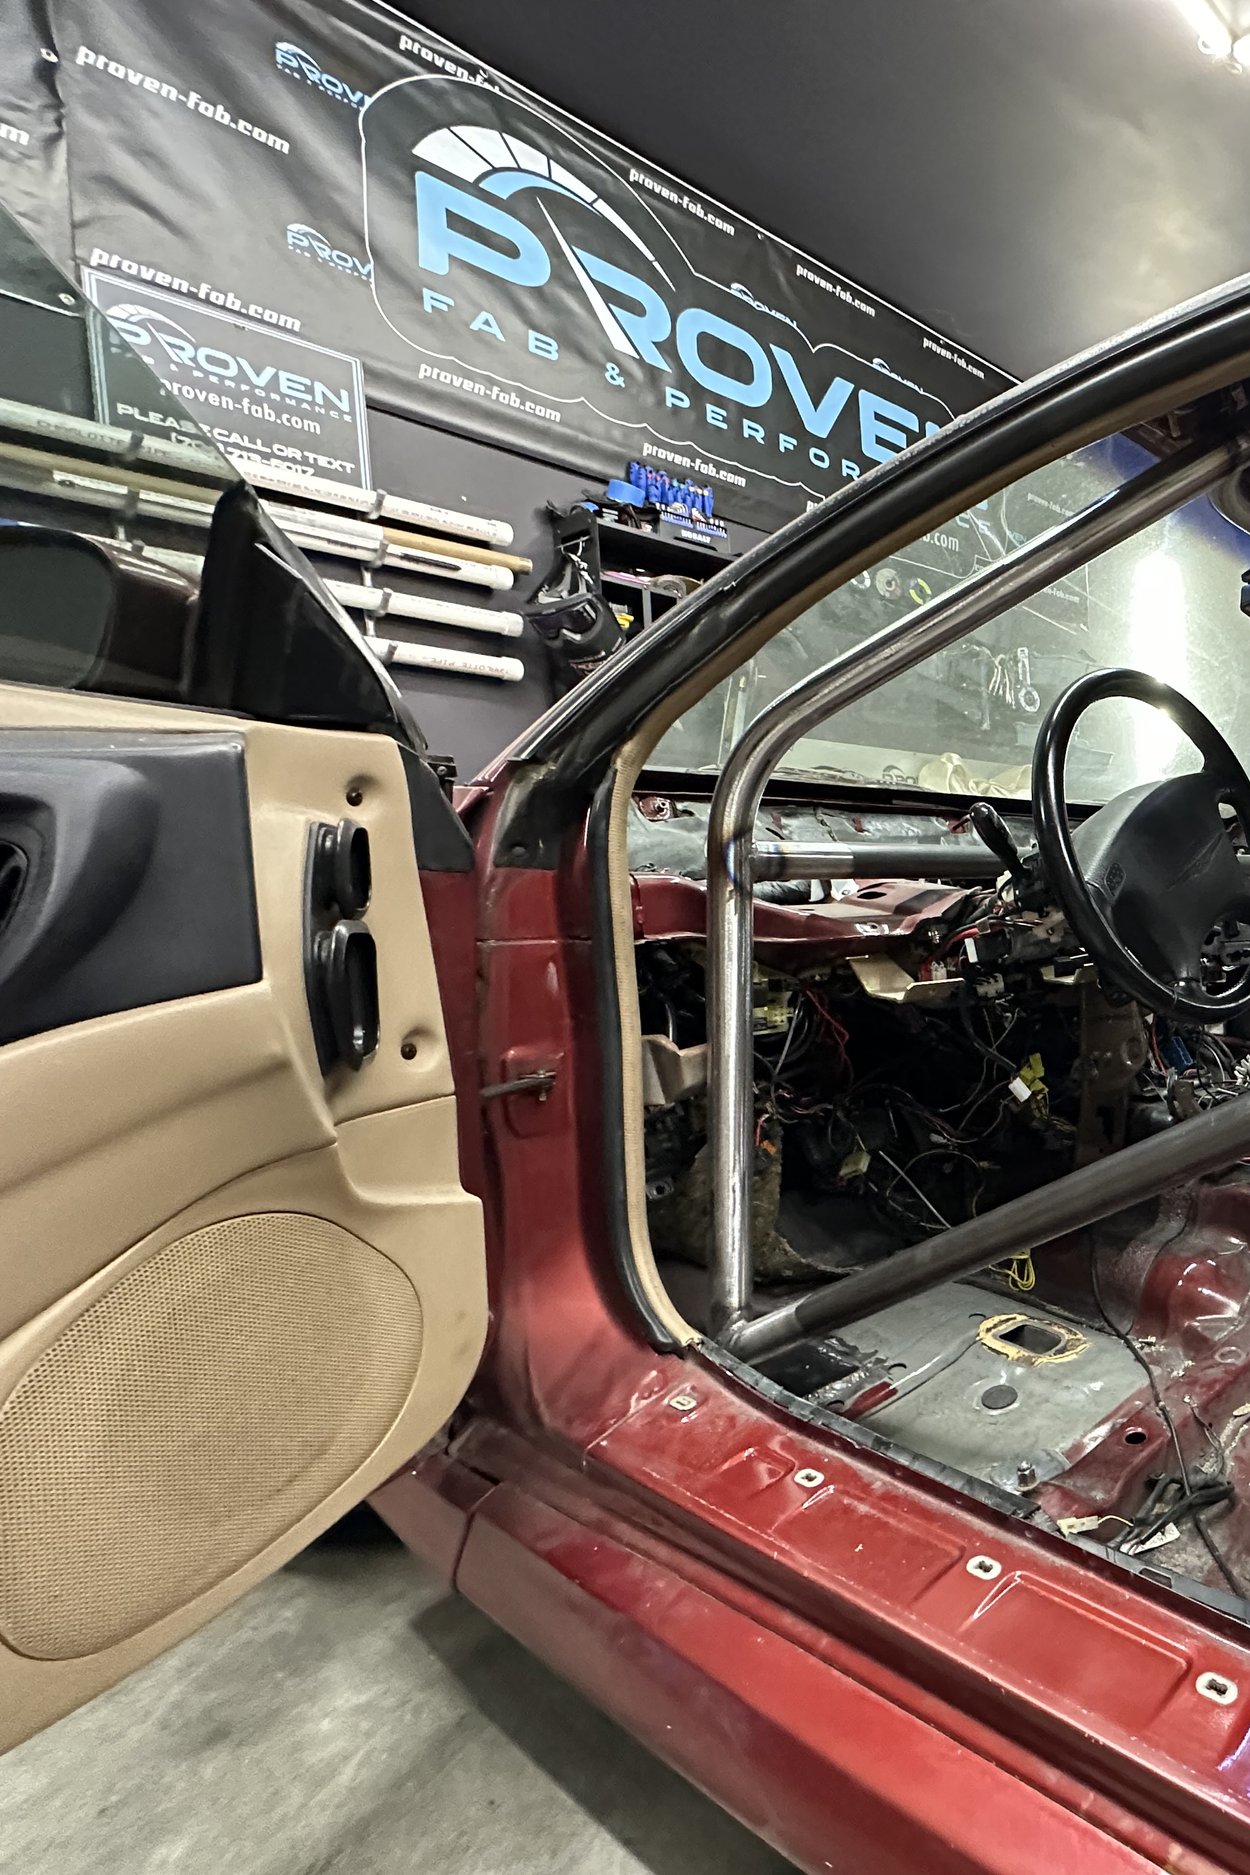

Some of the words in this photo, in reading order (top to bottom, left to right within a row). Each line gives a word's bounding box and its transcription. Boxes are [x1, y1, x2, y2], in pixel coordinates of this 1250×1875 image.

[76, 45, 290, 154] proven-fab.com
[629, 168, 735, 236] proven-fab.com
[90, 247, 301, 332] proven-fab.com
[796, 264, 876, 318] proven-fab.com
[422, 288, 559, 361] FAB
[604, 360, 626, 389] &
[418, 362, 562, 422] proven-fab.com
[212, 427, 272, 454] CALL
[272, 443, 302, 461] OR
[303, 451, 355, 474] TEXT
[642, 441, 747, 488] proven-fab.com
